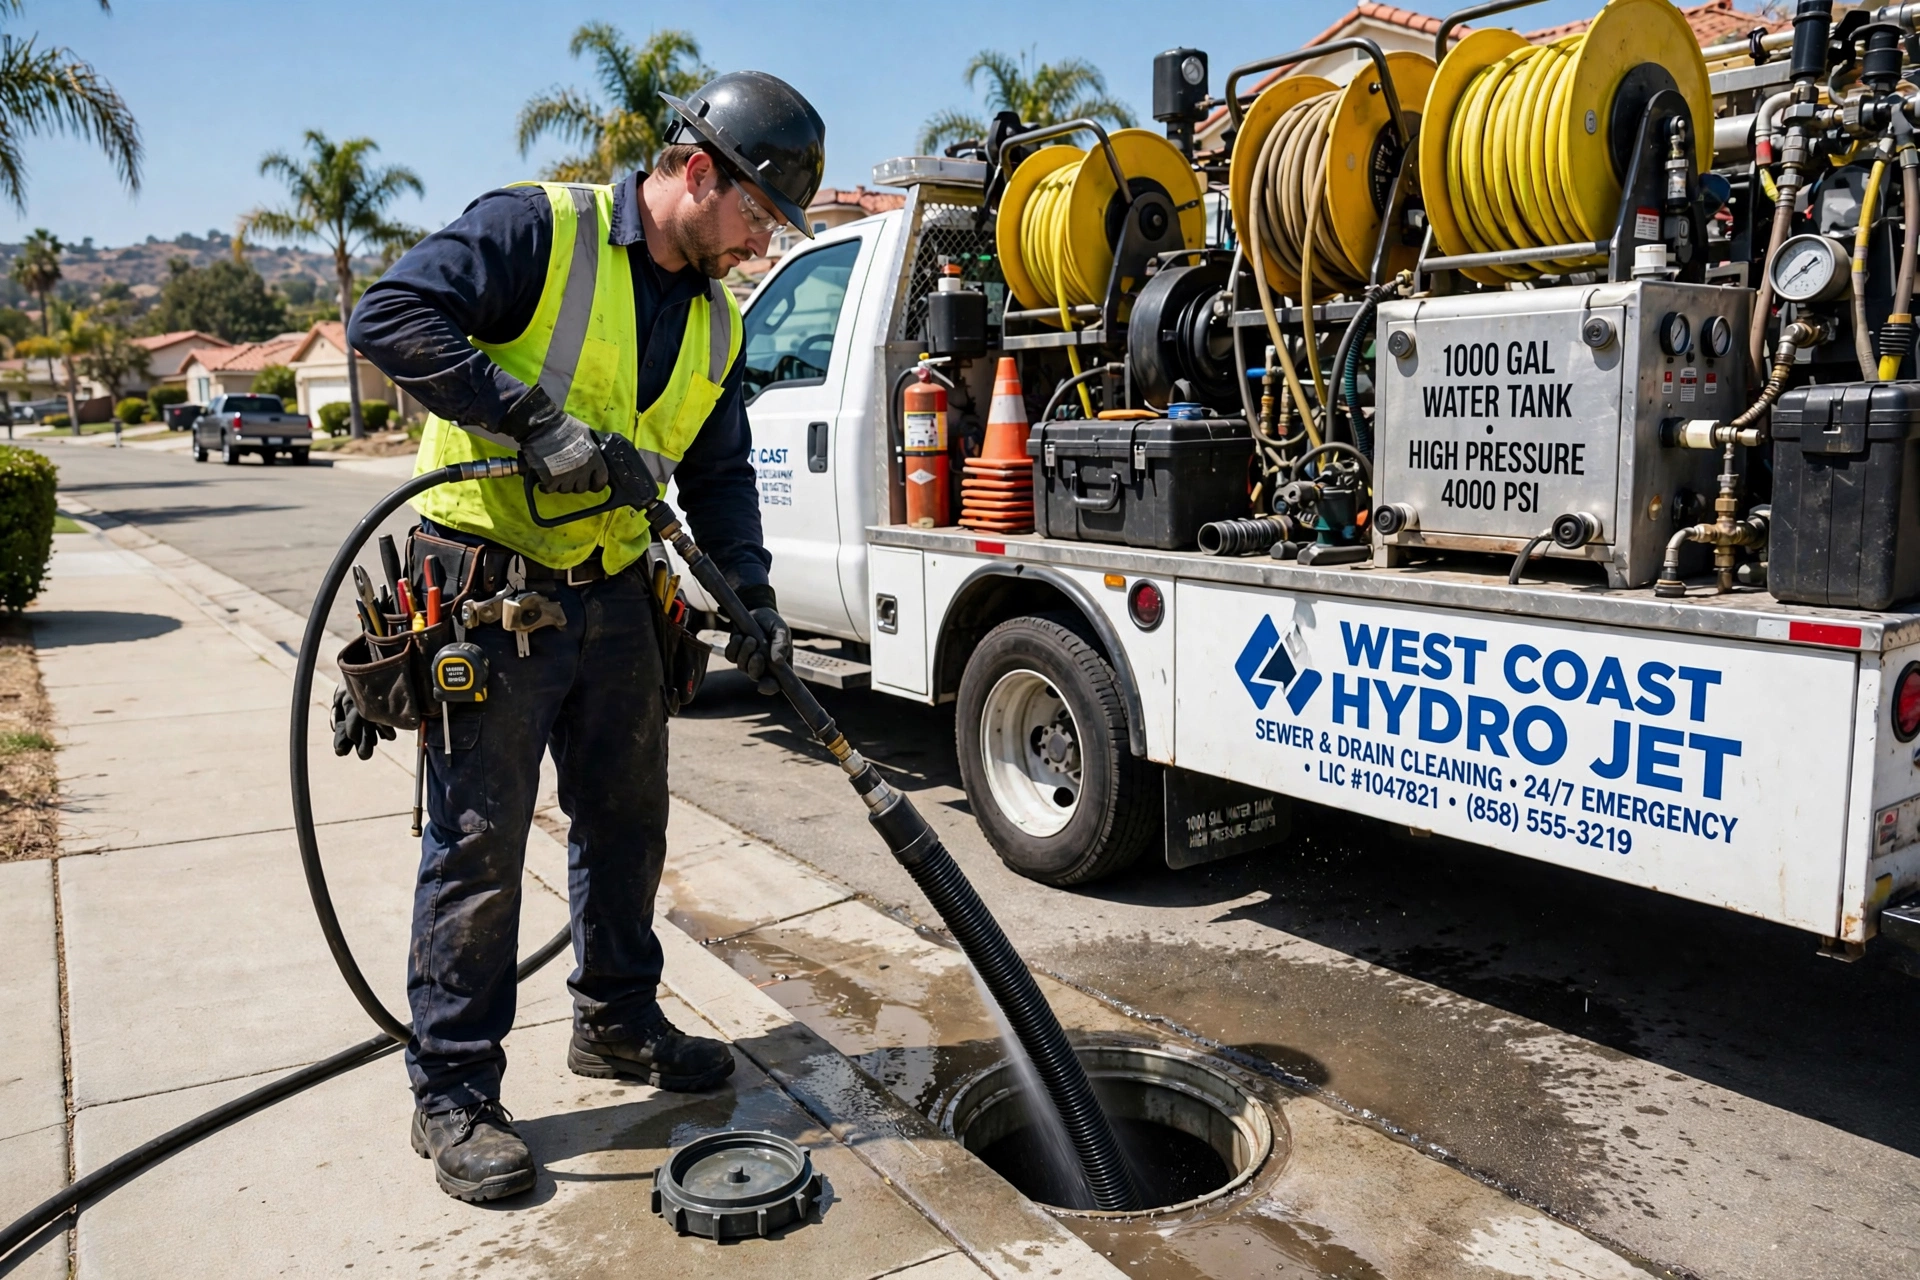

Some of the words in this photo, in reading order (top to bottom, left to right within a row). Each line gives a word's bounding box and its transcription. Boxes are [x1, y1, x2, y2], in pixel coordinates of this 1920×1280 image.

[1444, 343, 1498, 377] 1000
[1507, 341, 1555, 375] GAL
[1423, 385, 1499, 418] WATER
[1507, 384, 1573, 418] TANK
[1409, 440, 1458, 470] HIGH
[1466, 442, 1585, 475] PRESSURE
[1441, 479, 1496, 510] 4000
[1504, 482, 1539, 513] PSI
[1339, 621, 1487, 685] WEST
[1503, 644, 1722, 722] COAST
[1332, 673, 1568, 766] HYDRO
[1589, 720, 1742, 800] JET
[1255, 718, 1314, 750] SEWER
[1319, 732, 1332, 754] &
[1337, 735, 1395, 768] DRAIN
[1401, 748, 1502, 793] CLEANING
[1523, 774, 1575, 807] 24/7
[1581, 785, 1739, 844] EMERGENCY
[1319, 761, 1345, 787] LIC
[1351, 768, 1438, 809] #1047821
[1466, 793, 1519, 832] (858)
[1526, 808, 1633, 855] 555-3219
